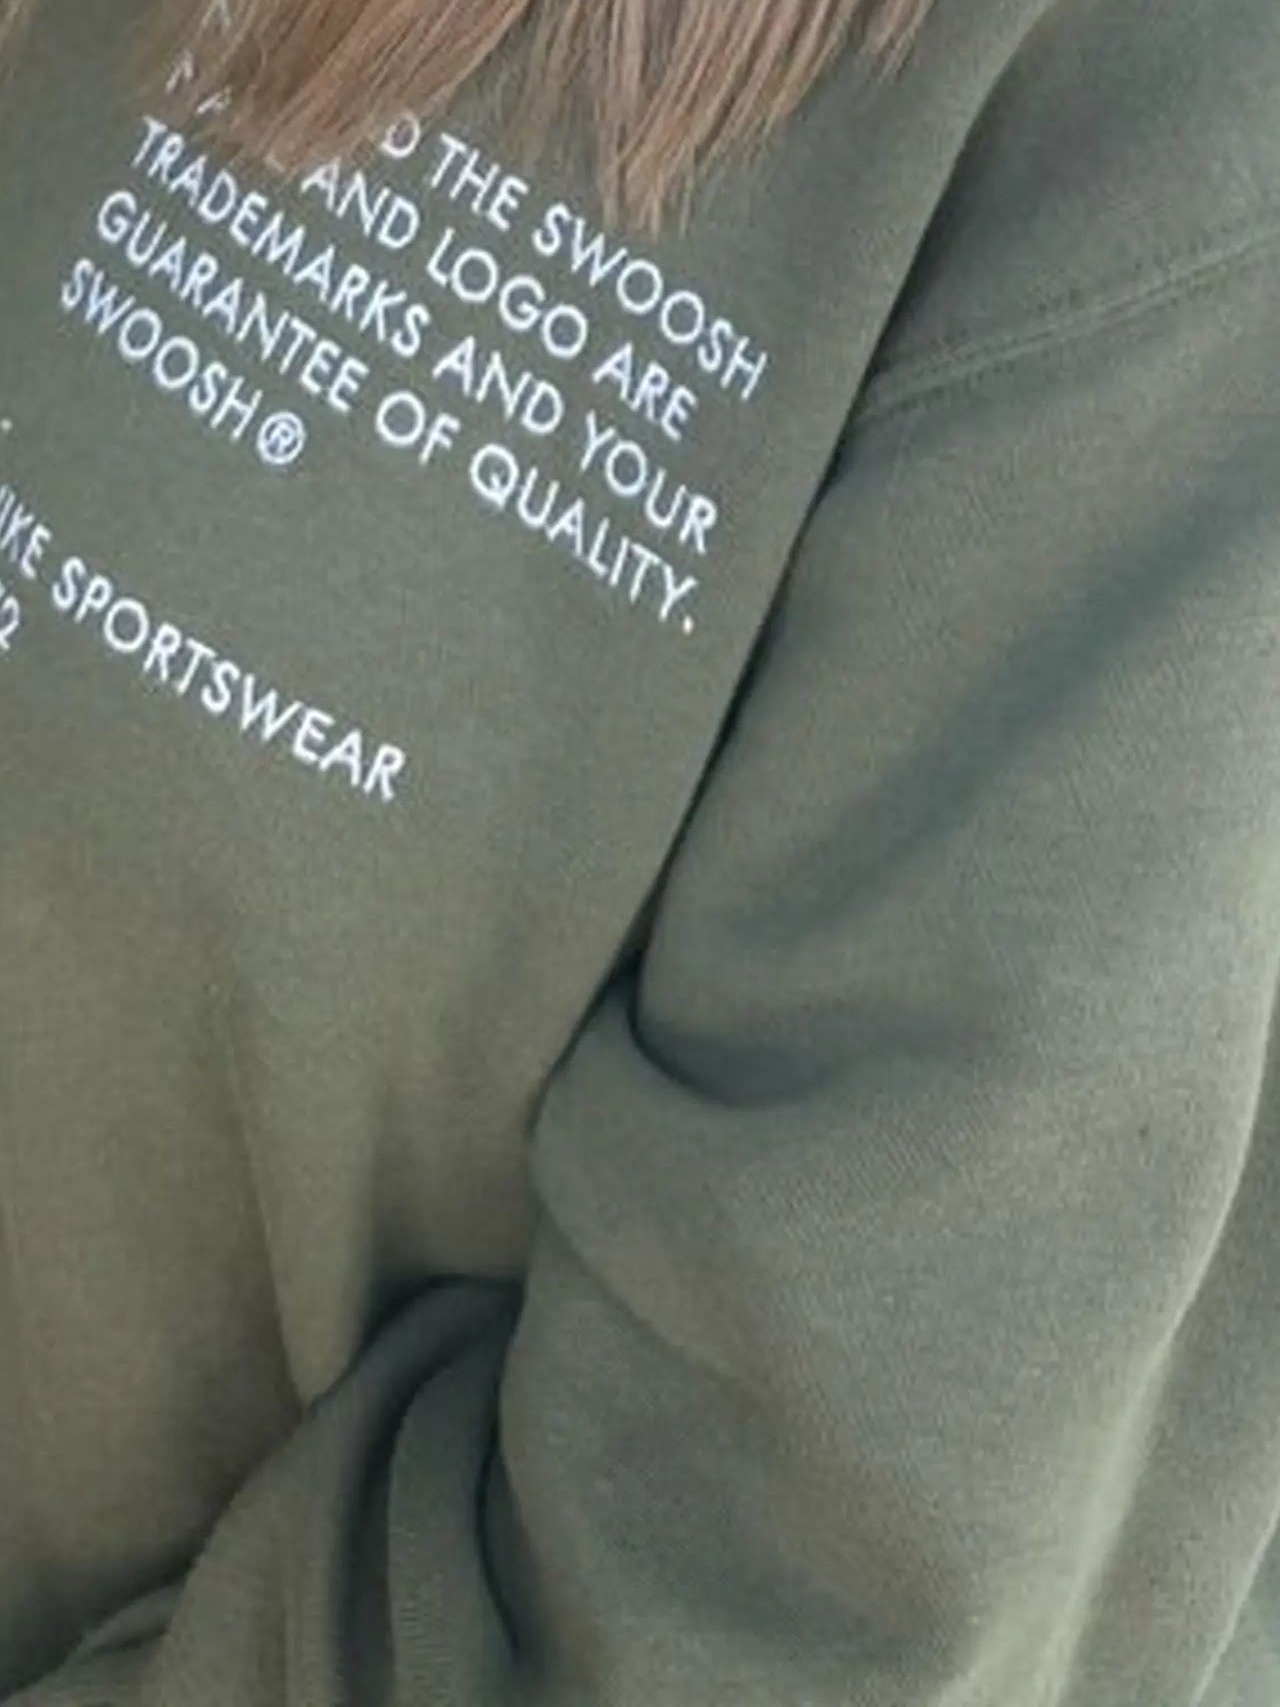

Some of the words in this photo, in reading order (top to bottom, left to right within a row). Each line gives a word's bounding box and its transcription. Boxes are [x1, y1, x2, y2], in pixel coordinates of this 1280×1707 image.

[131, 114, 431, 359] TRADEMARKS
[431, 334, 565, 436] AND
[579, 410, 718, 556] YOUR
[299, 155, 421, 250] AND
[426, 226, 589, 359] LOGO
[591, 341, 698, 442] ARE
[429, 132, 529, 232] THE
[531, 201, 768, 402] SWOOSH
[95, 189, 370, 414] GUARANTEE
[374, 390, 462, 467] OF
[468, 442, 699, 636] QUALITY.
[51, 555, 407, 803] SPORTSWEAR
